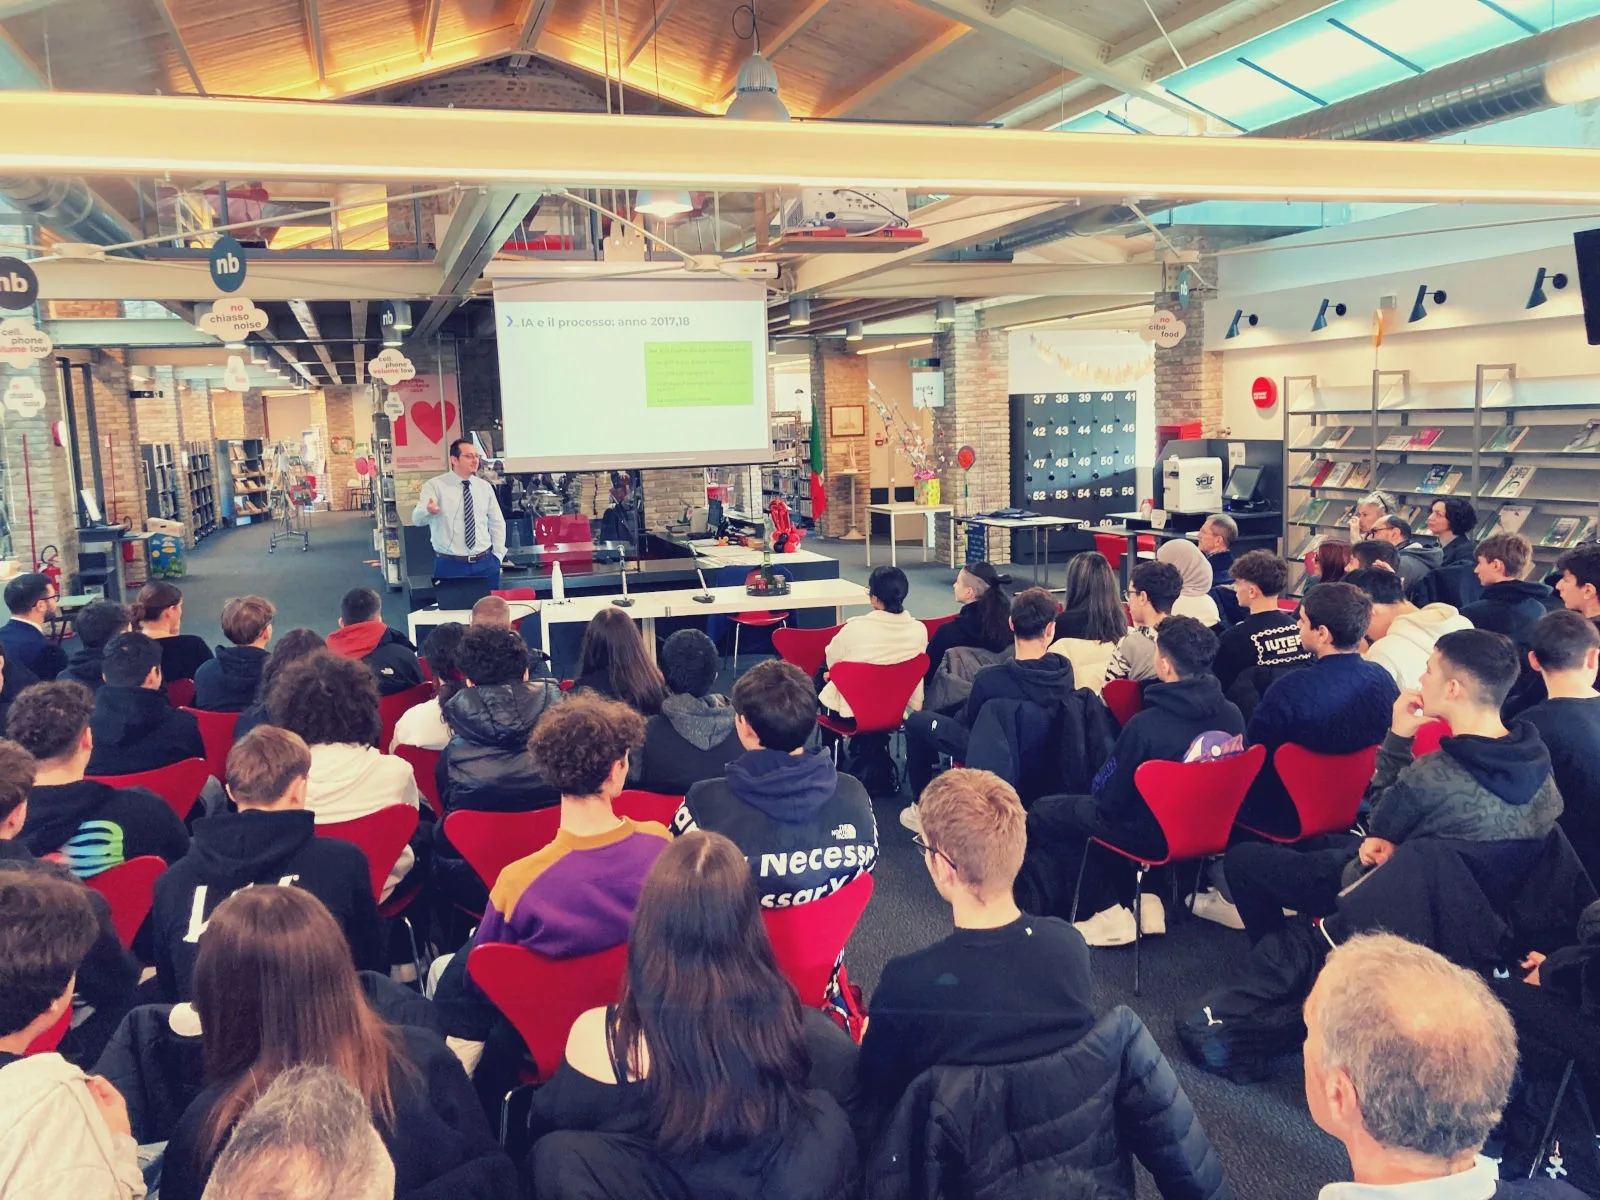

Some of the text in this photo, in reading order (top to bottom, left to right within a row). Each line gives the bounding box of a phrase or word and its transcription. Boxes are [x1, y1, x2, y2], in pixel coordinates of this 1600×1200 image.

[216, 252, 240, 274] nb
[0, 272, 28, 293] nb
[210, 314, 249, 323] chiasso
[382, 310, 394, 326] nb
[521, 317, 534, 327] IA
[537, 319, 545, 327] e
[548, 317, 555, 327] il
[558, 318, 615, 329] processo:
[617, 318, 647, 327] anno
[233, 319, 262, 331] noise
[11, 337, 44, 346] phone
[30, 345, 48, 353] low
[1033, 391, 1136, 404] 37 38 39 40 41
[1033, 423, 1135, 437] 42 43 44 45 46
[1033, 455, 1135, 469] 47 48 49 50 51
[1033, 486, 1134, 501] 52 53 54 55 56
